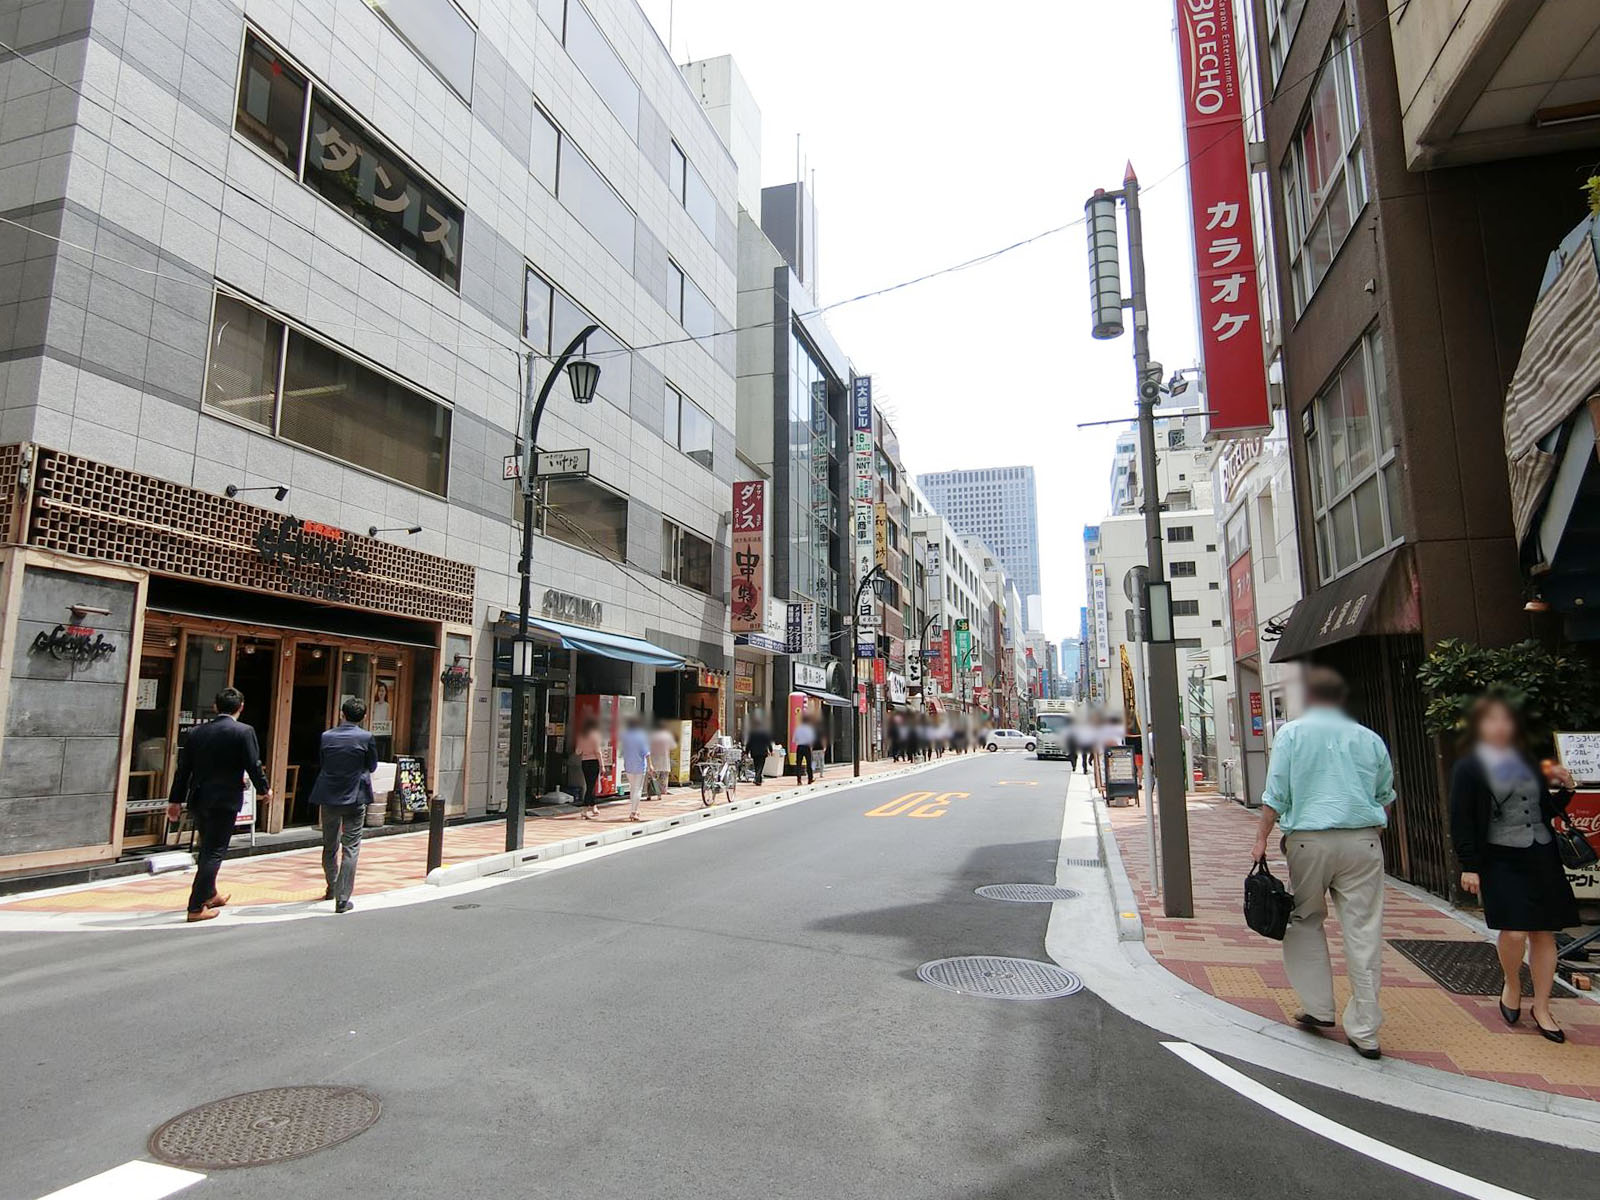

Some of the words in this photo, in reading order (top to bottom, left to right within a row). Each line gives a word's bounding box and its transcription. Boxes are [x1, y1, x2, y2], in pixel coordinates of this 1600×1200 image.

[1219, 0, 1228, 31] araoke
[1195, 41, 1223, 114] ECHO
[1222, 34, 1234, 98] Entertainment
[316, 126, 455, 259] ダンス
[1204, 200, 1250, 342] カラオケ
[855, 433, 865, 443] 16
[856, 462, 871, 470] NNT
[740, 483, 756, 529] ダンス
[857, 505, 867, 539] 一六商事
